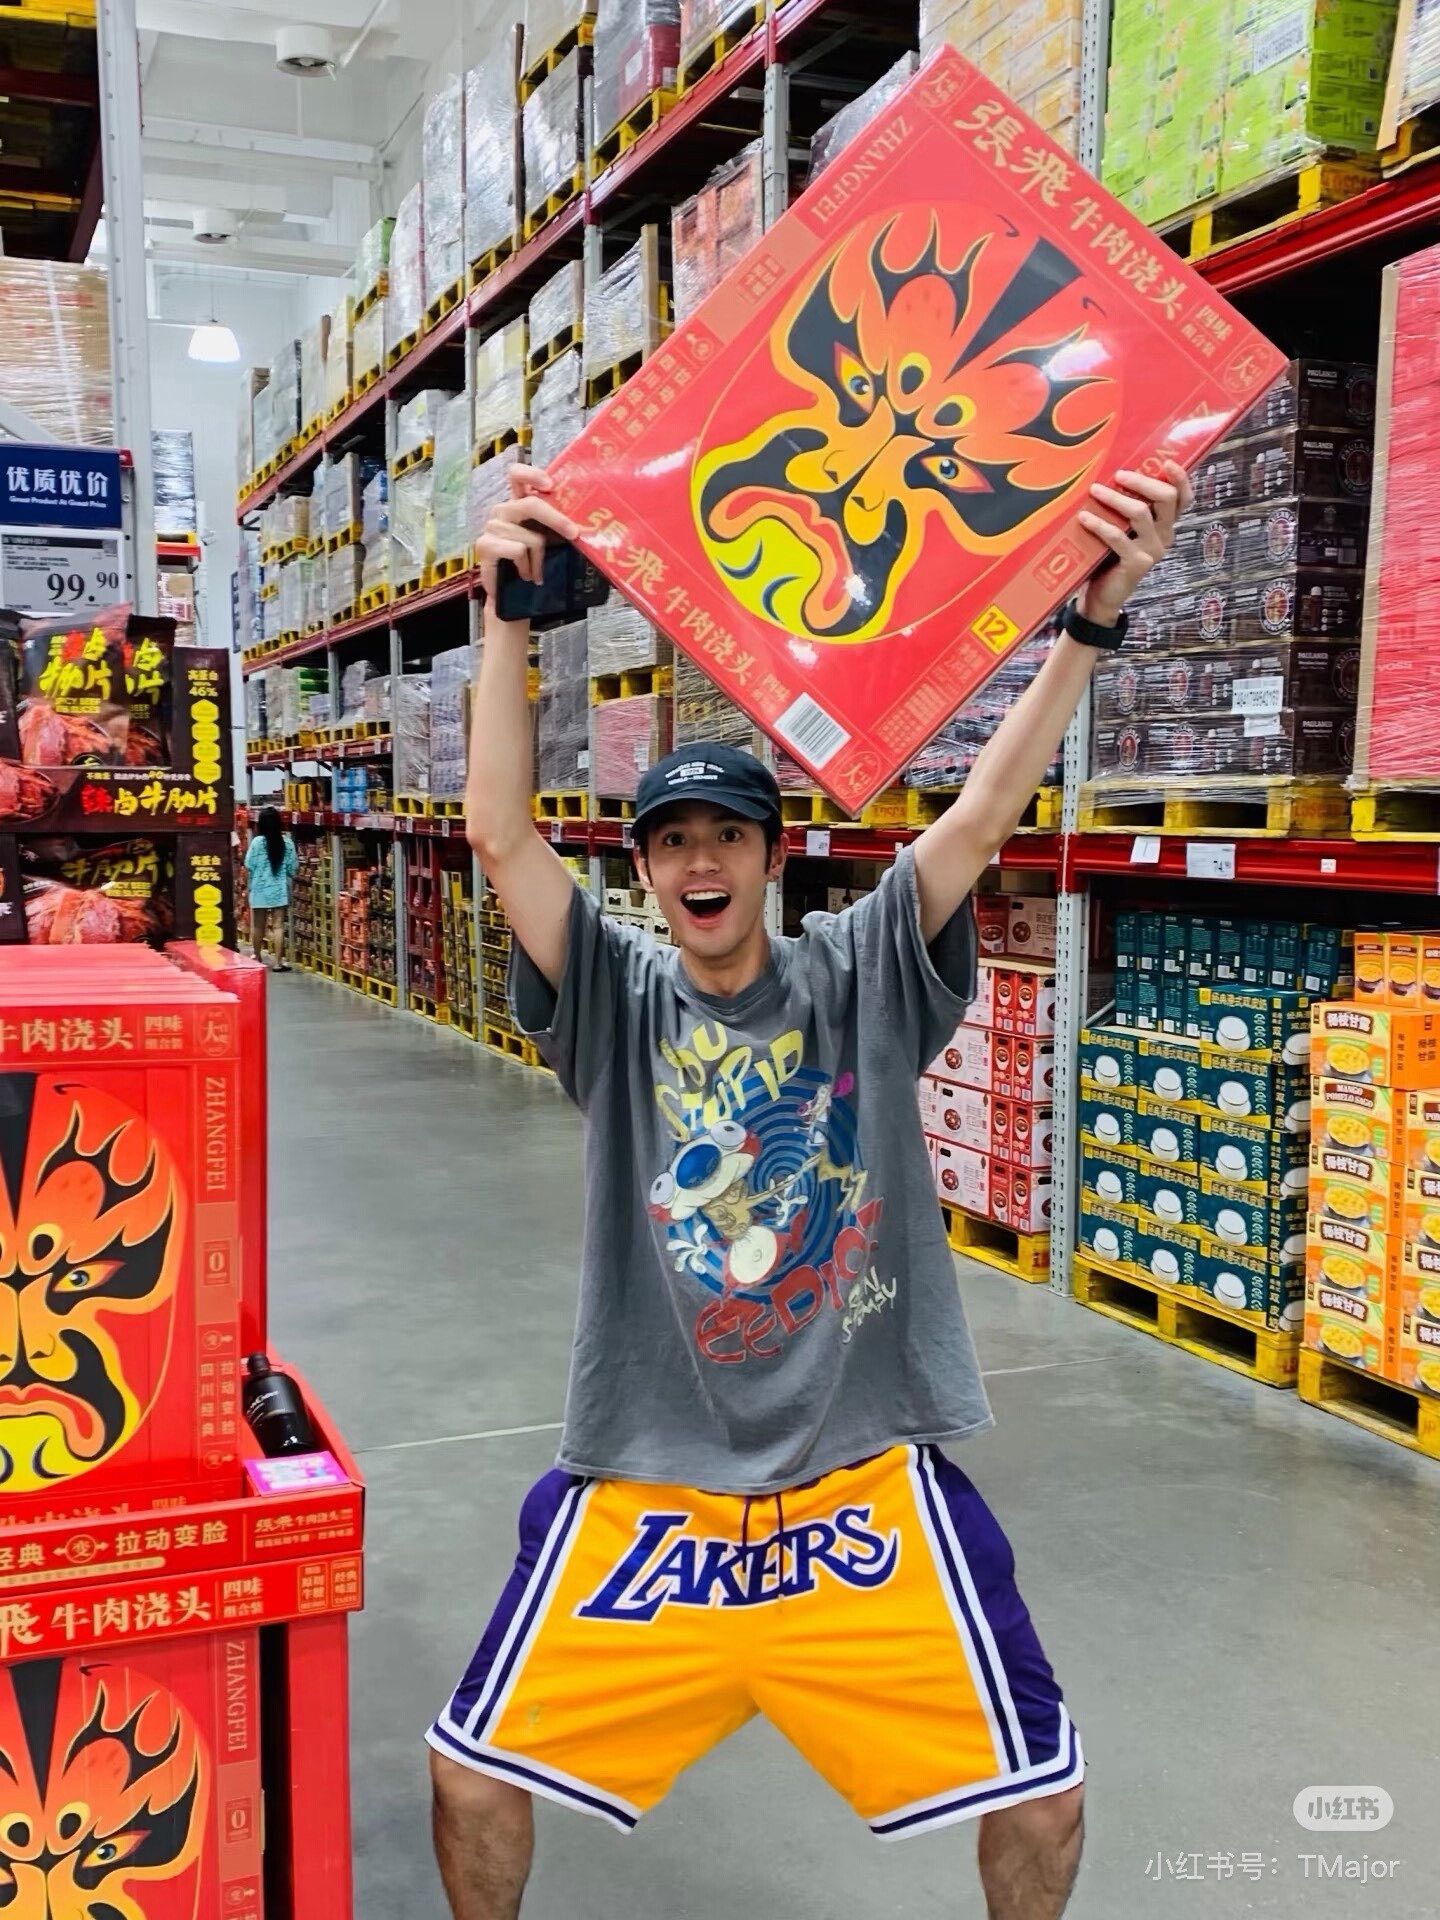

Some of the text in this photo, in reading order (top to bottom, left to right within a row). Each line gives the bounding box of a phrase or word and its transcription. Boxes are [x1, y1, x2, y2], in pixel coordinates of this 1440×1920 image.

[811, 116, 913, 224] ZHANGFEI
[1068, 196, 1188, 321] 牛肉浇头
[1195, 304, 1235, 342] 四味
[6, 466, 110, 498] 优质优价
[47, 571, 119, 602] 99.90
[664, 585, 759, 687] 牛肉浇头
[977, 611, 1009, 646] 12
[188, 687, 219, 697] 46%
[191, 871, 222, 882] 46%
[145, 1015, 183, 1032] 四味
[655, 1030, 804, 1143] STUPID
[1336, 1084, 1364, 1095] MANGO
[204, 1076, 227, 1191] ZHANGFEI
[1325, 1155, 1371, 1179] 杨枝甘露
[1322, 1223, 1367, 1250] 杨枝甘露
[1321, 1291, 1366, 1319] 杨枝甘露
[116, 1521, 228, 1556] 拉动变脸
[571, 1501, 903, 1626] LAKERS
[223, 1577, 263, 1600] 四味
[51, 1586, 211, 1641] 牛肉浇头
[226, 1641, 248, 1752] ZHANGFEI
